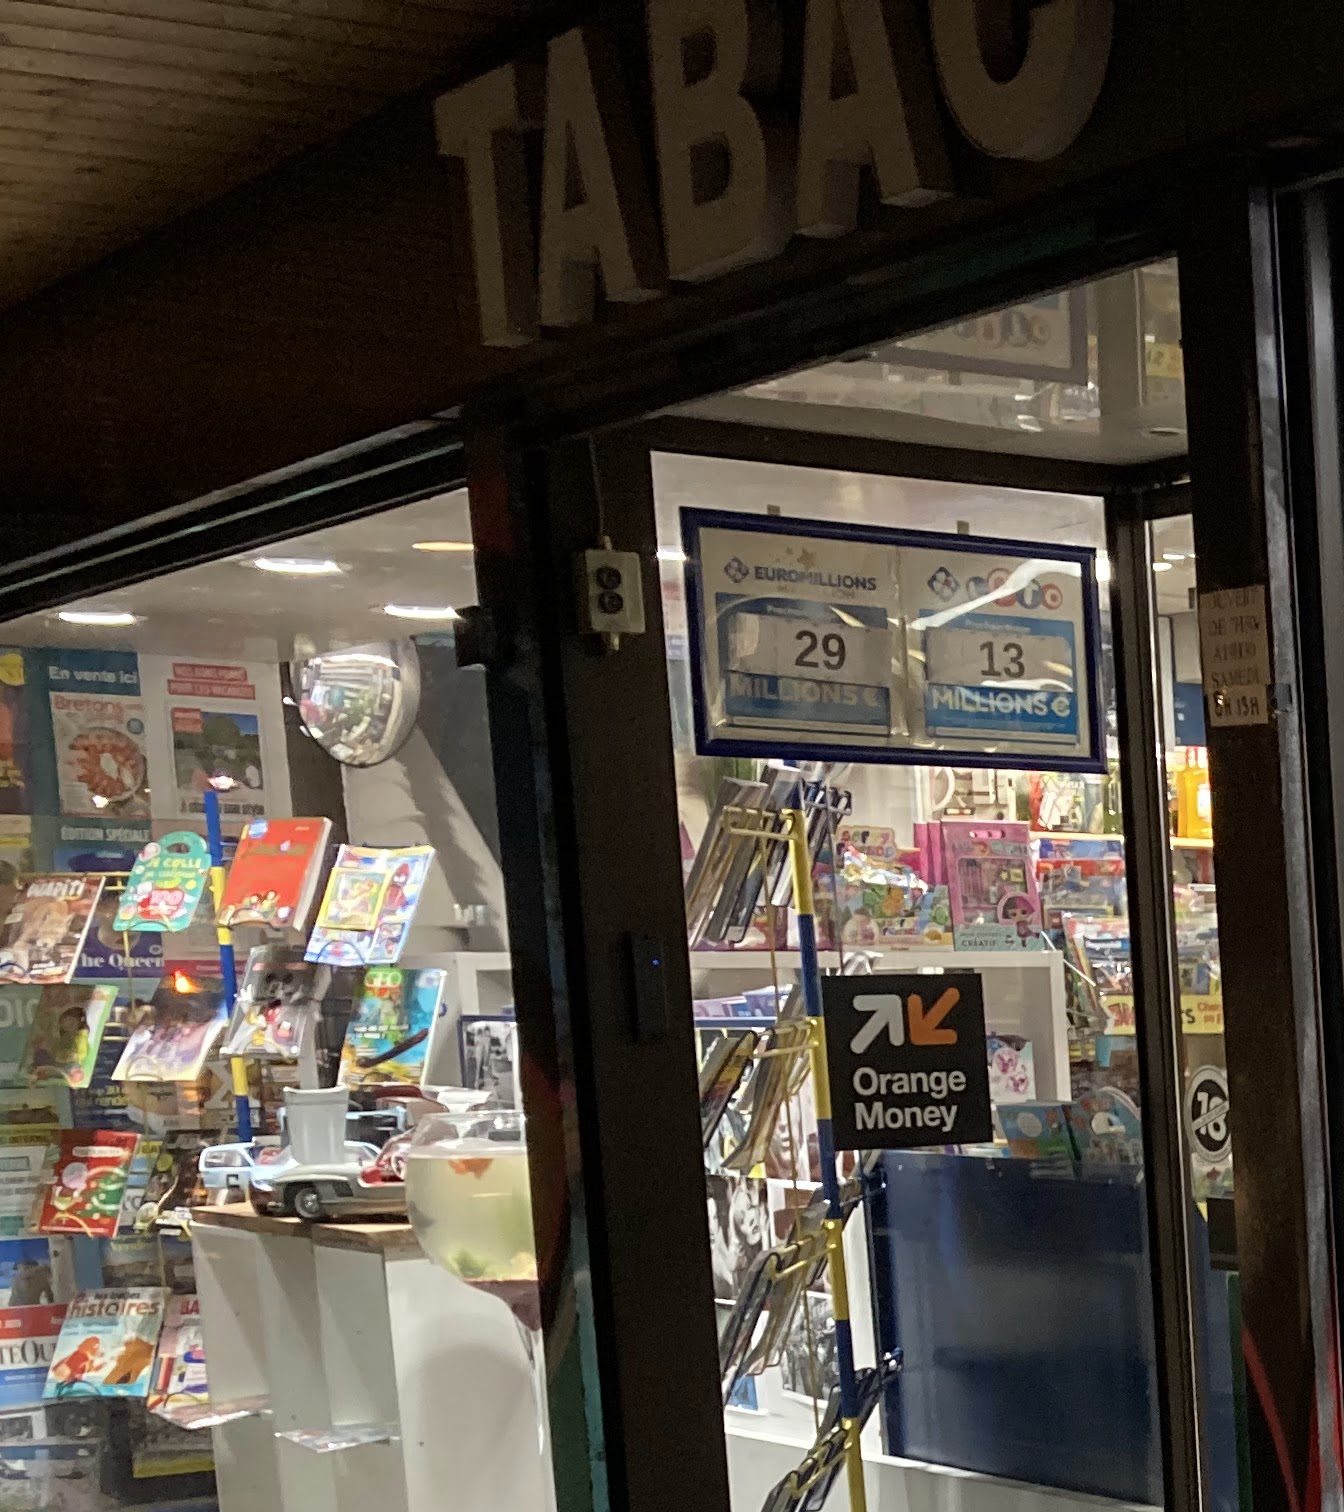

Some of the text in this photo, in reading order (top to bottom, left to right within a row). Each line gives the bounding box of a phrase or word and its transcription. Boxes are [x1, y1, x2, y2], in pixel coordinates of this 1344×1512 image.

[754, 566, 876, 592] EUROMILLIONS
[795, 630, 846, 670] 29
[980, 641, 1025, 678] 13
[729, 672, 859, 705] MILLIONS
[933, 690, 1047, 716] MILLIONS
[852, 1066, 966, 1098] Orange
[855, 1100, 957, 1133] Money
[70, 1300, 161, 1317] histoires
